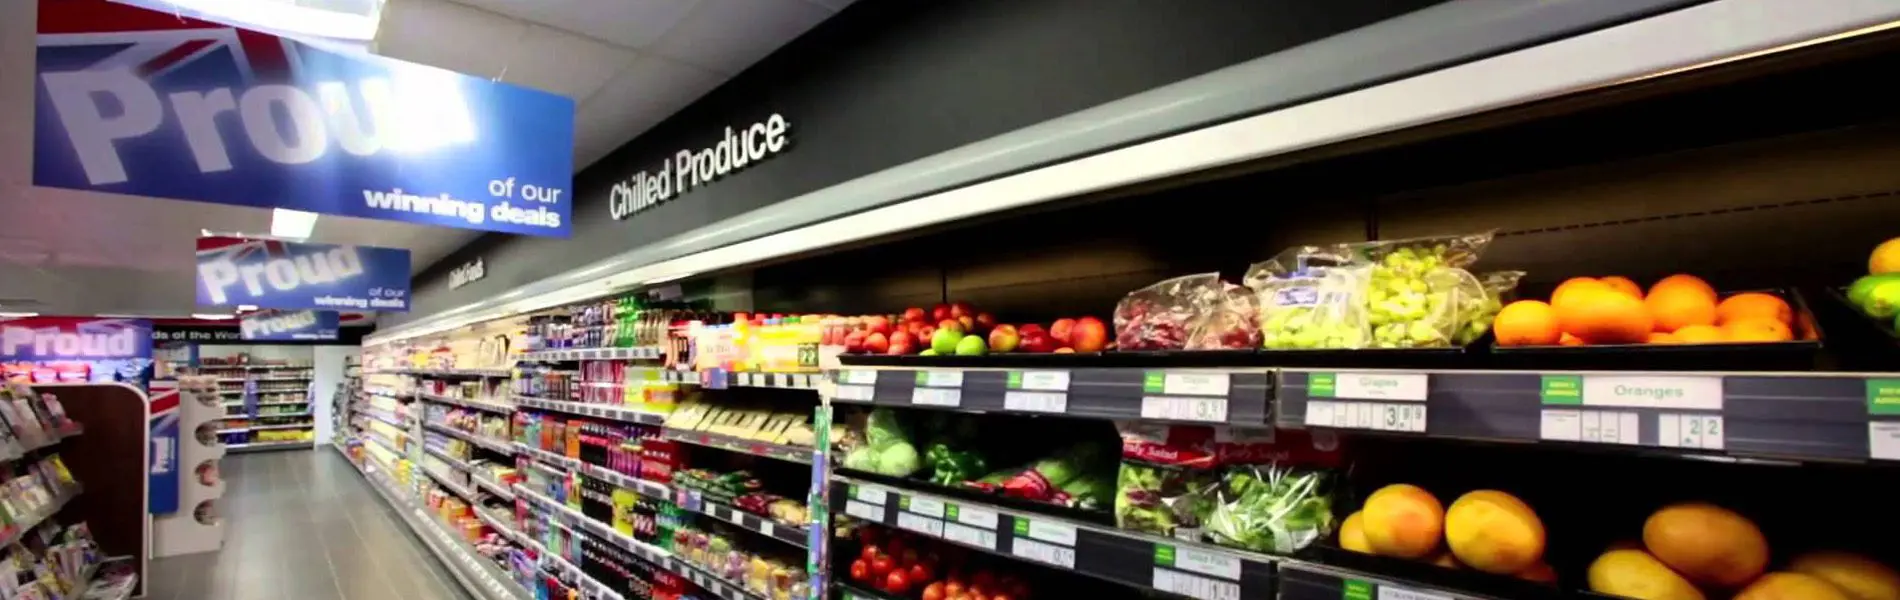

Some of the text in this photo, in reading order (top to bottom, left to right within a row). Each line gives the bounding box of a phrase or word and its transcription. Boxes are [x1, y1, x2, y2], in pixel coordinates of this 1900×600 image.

[609, 113, 786, 221] Chilled Produce
[488, 177, 562, 204] of our
[362, 187, 561, 228] winning deals
[198, 245, 363, 305] Proud
[1, 326, 135, 356] Proud
[172, 330, 186, 341] of
[189, 330, 211, 341] the
[214, 330, 243, 341] Wor
[1614, 384, 1684, 400] Oranges
